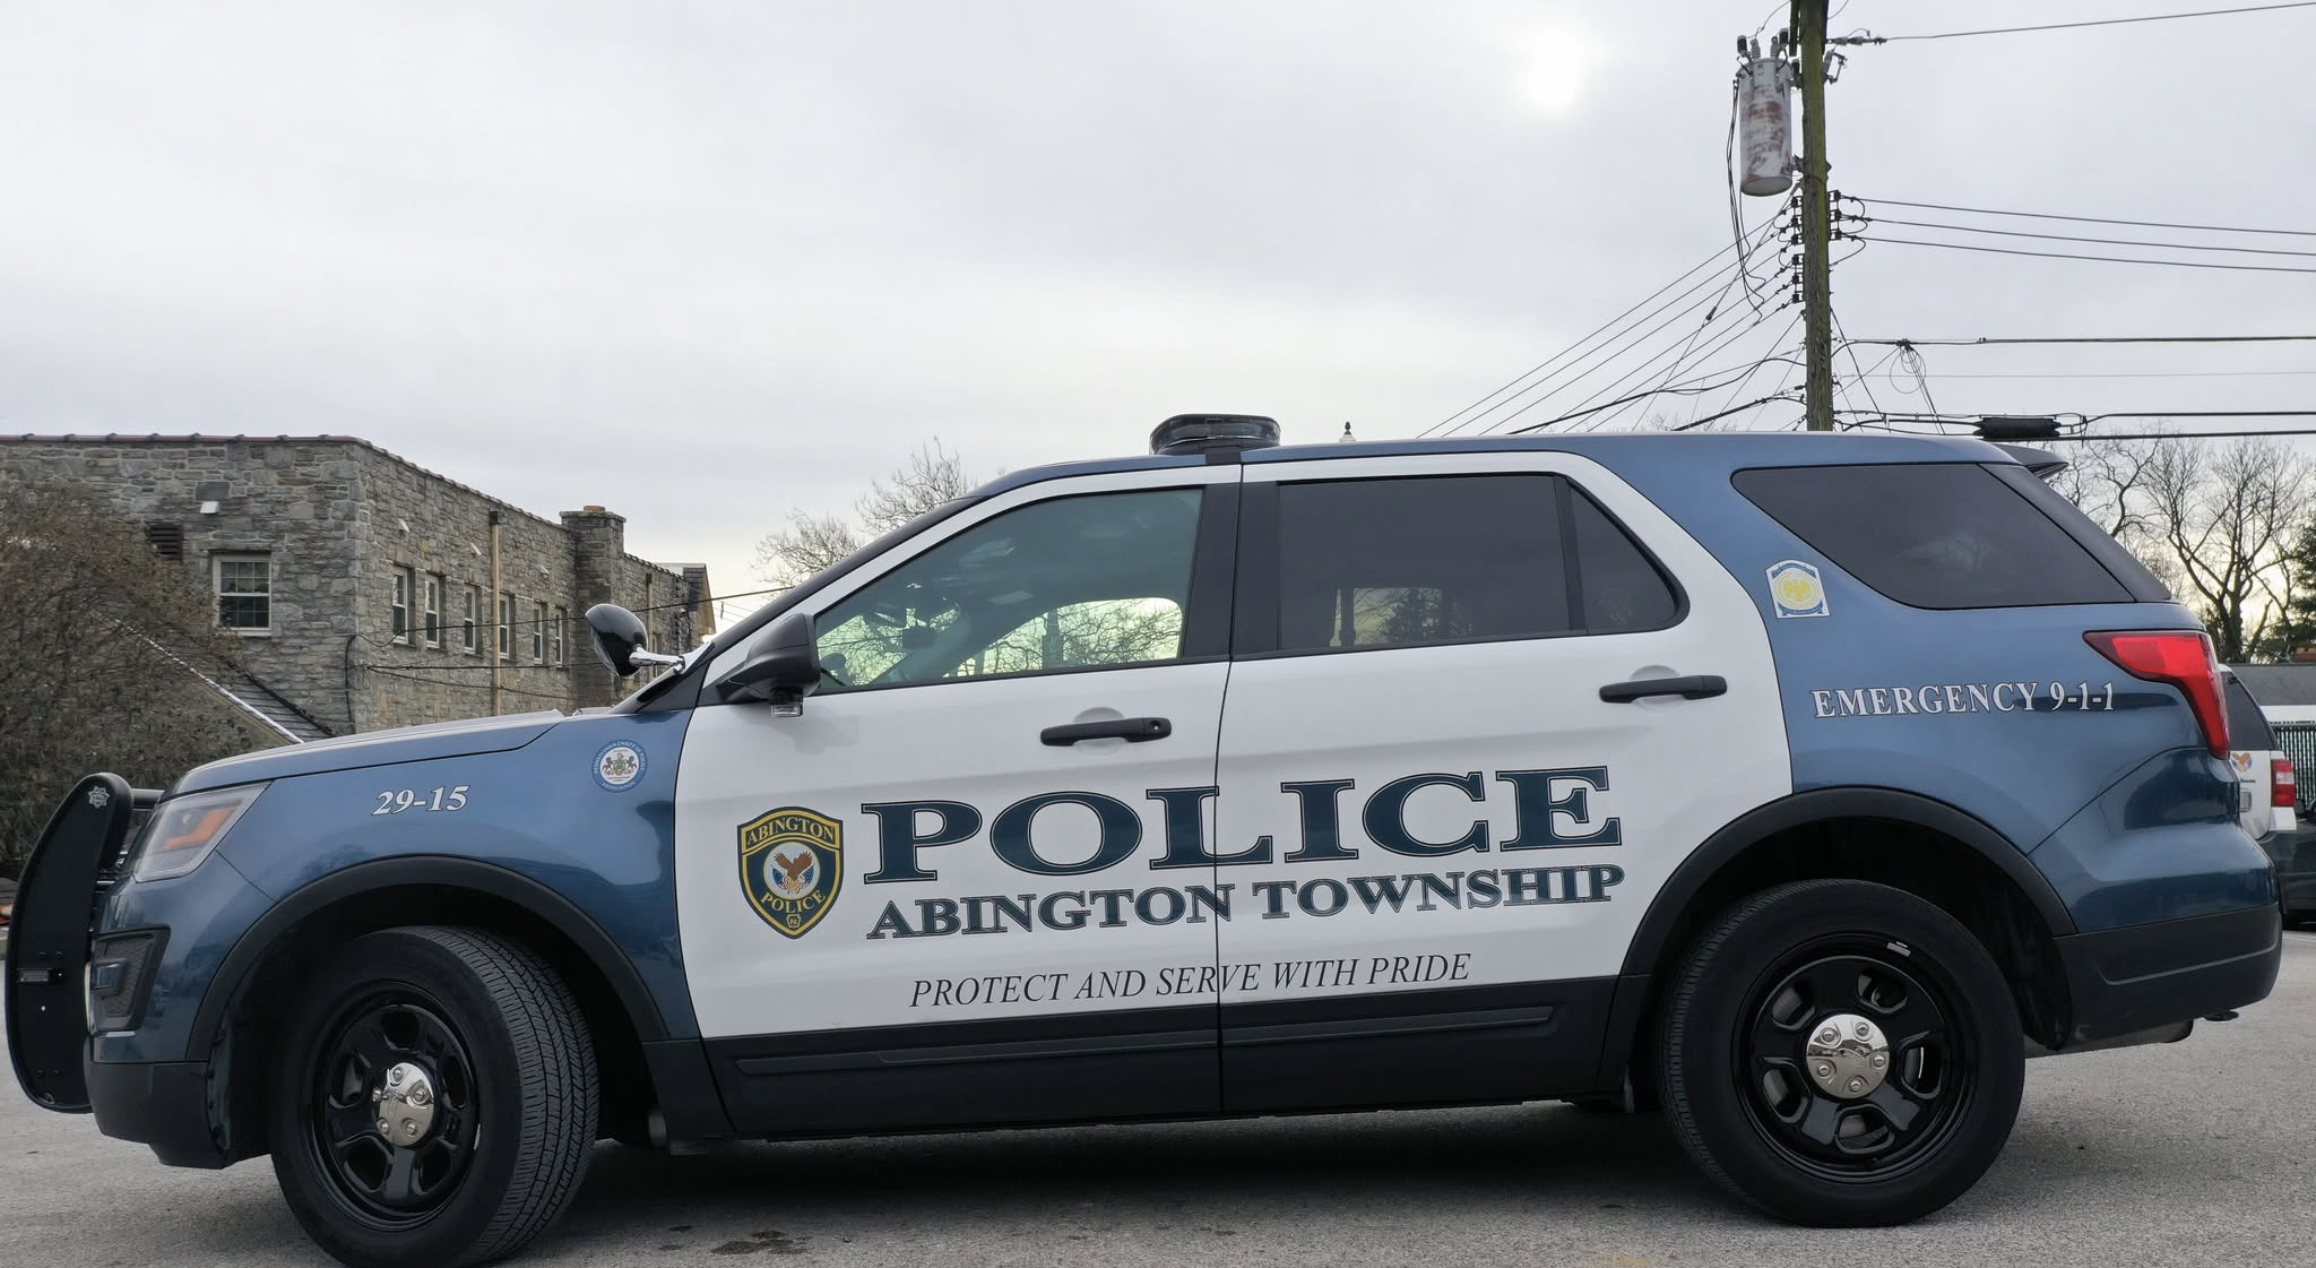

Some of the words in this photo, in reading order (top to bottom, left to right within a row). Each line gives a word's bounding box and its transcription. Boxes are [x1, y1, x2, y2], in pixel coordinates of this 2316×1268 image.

[1811, 682, 2039, 717] EMERGENCY
[2049, 681, 2115, 711] 9-1-1
[371, 785, 471, 816] 29-15
[746, 816, 834, 845] ABINGTON
[861, 766, 1622, 884] POLICE
[760, 890, 826, 914] POLICE
[866, 884, 1236, 940] ABINGTON
[1252, 864, 1625, 919] TOWNSHIP
[909, 973, 1068, 1007] PROTECT
[1074, 970, 1146, 999] AND
[1156, 963, 1261, 996] SERVE
[1273, 958, 1360, 989] WITH
[1366, 953, 1471, 984] PRIDE
